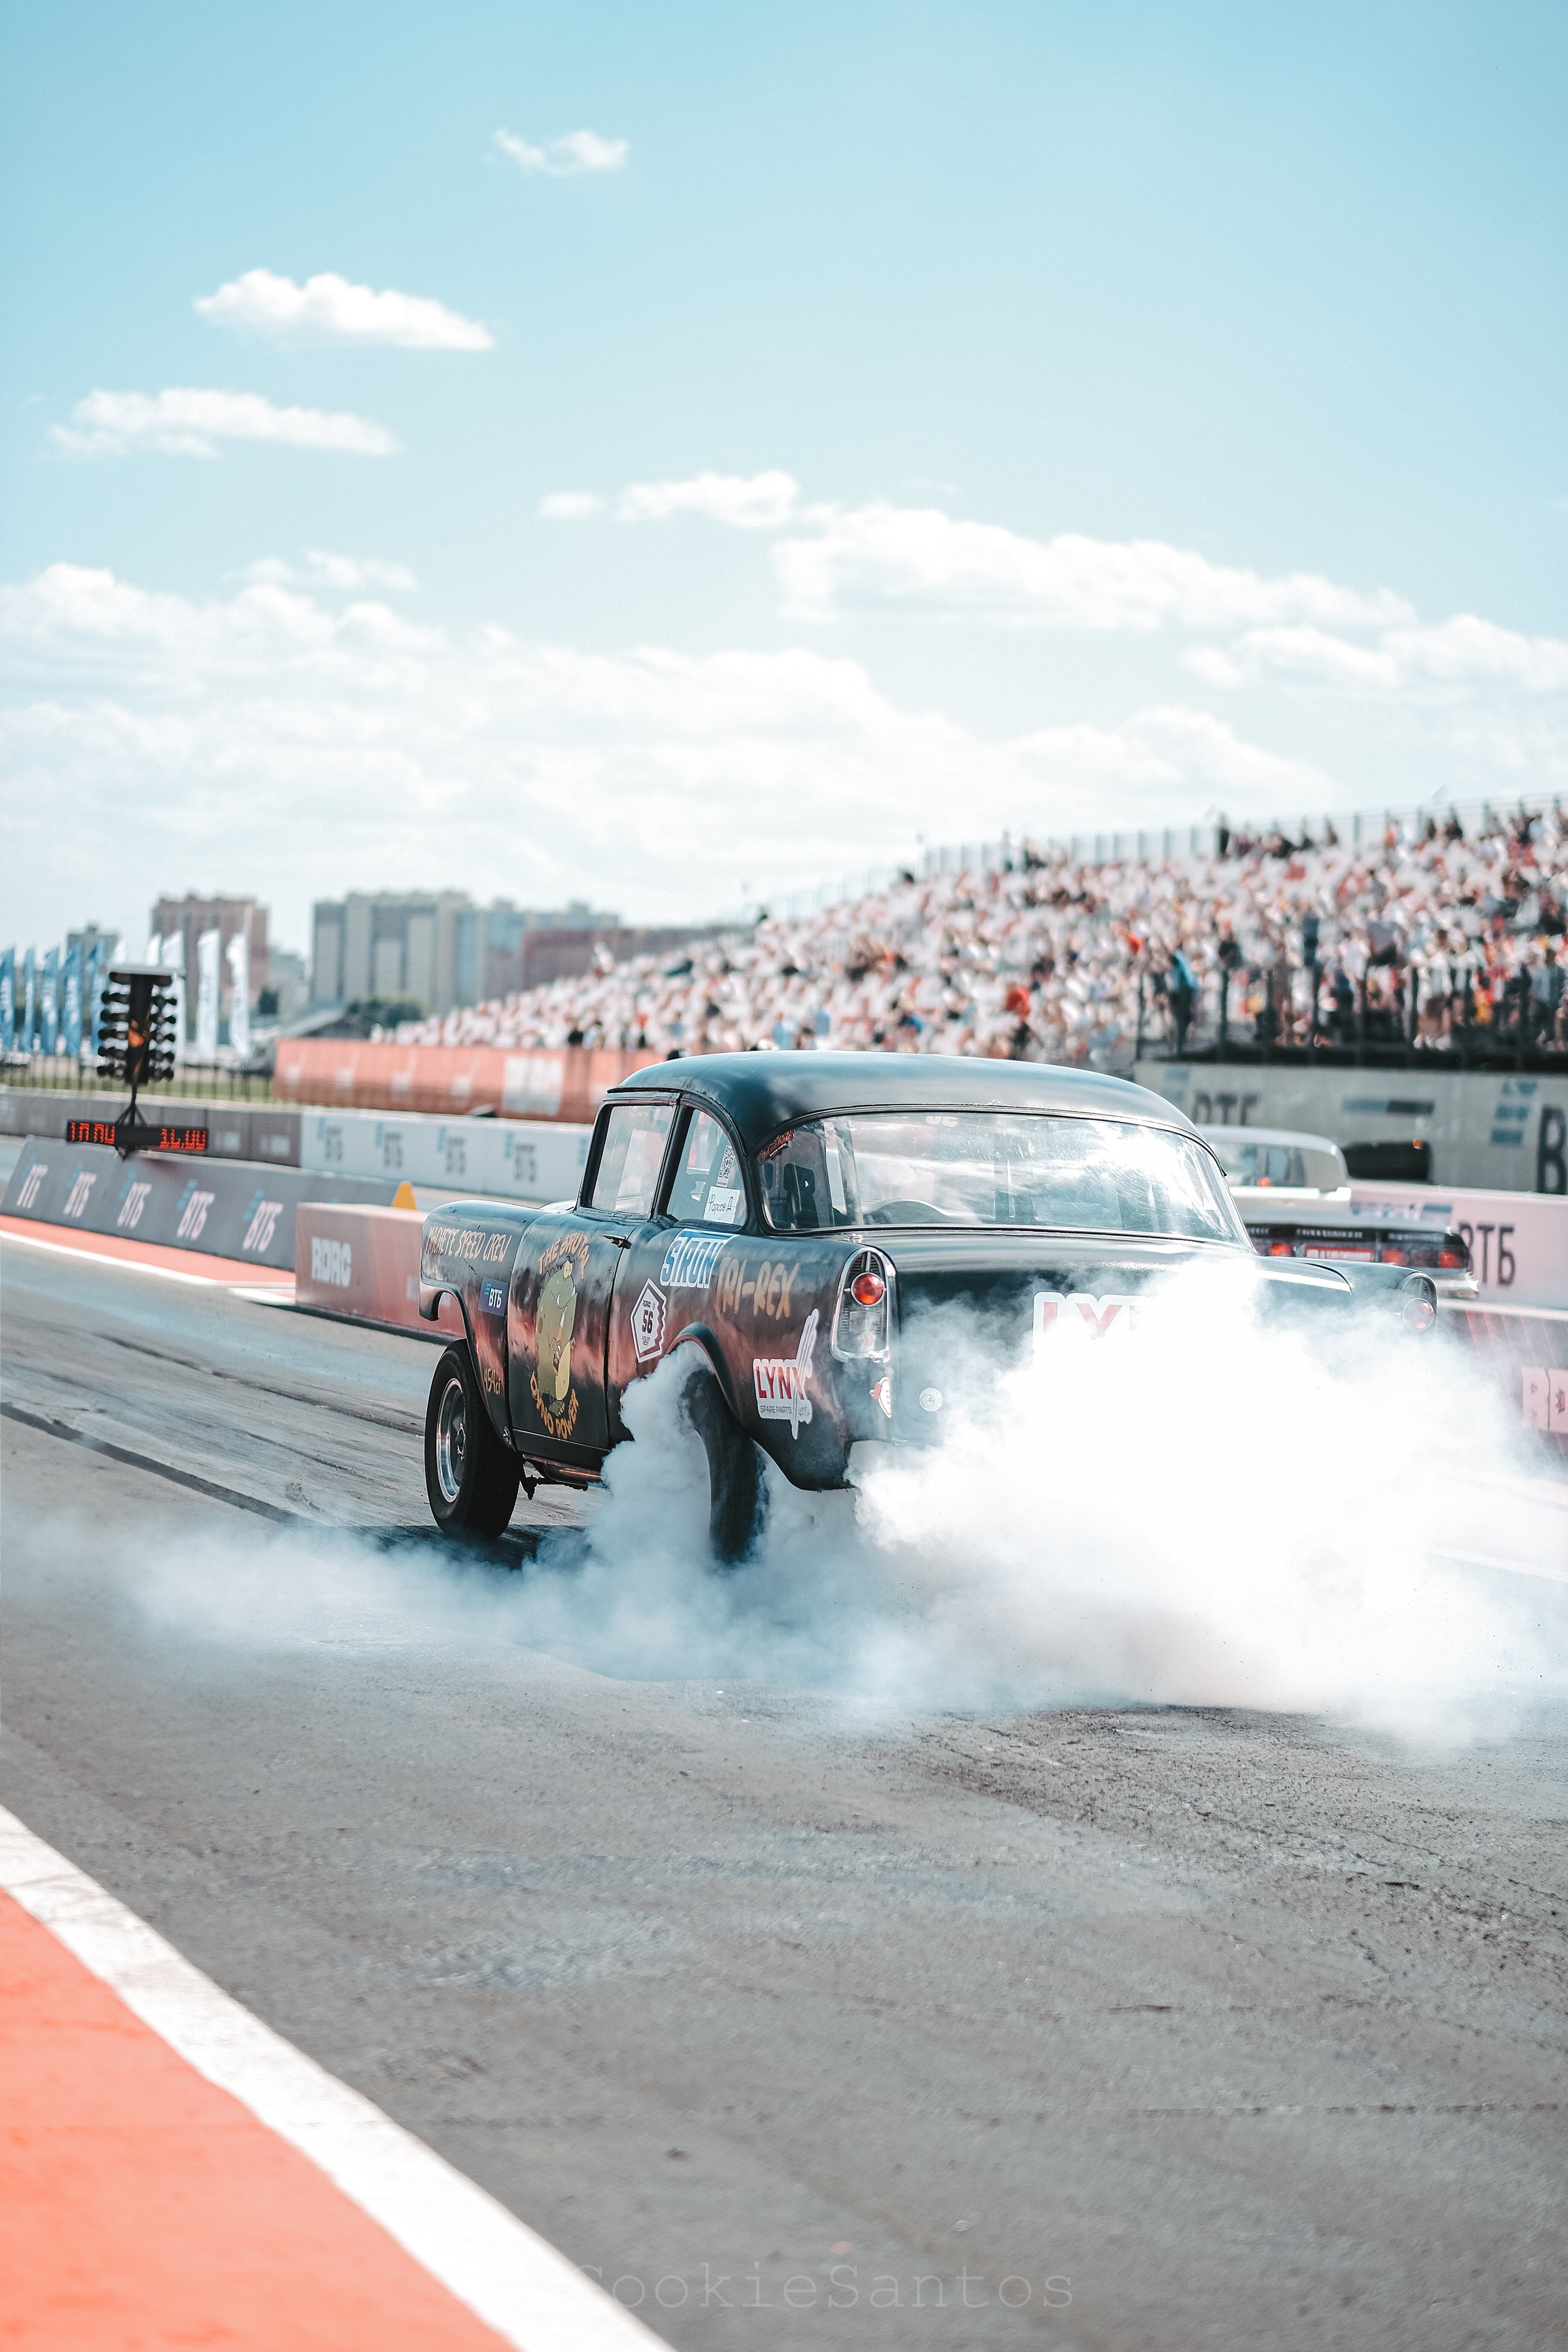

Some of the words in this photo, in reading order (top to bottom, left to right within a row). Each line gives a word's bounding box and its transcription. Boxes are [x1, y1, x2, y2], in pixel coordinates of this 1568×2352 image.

[117, 1182, 152, 1229] ВТБ
[177, 1191, 215, 1241] ВТБ
[242, 1200, 284, 1252] ВТБ
[426, 1226, 459, 1257] MACHETE
[454, 1230, 486, 1260] SPEED
[483, 1233, 512, 1262] CREW
[311, 1236, 352, 1289] RDRC
[538, 1237, 562, 1275] THE
[488, 1288, 503, 1308] ВТБ
[715, 1257, 801, 1321] TRI-REX
[641, 1309, 654, 1334] 56
[483, 1368, 501, 1395] 454ci
[755, 1365, 805, 1401] LYNX
[530, 1371, 554, 1434] DYNO
[555, 1388, 579, 1439] POWER
[760, 1404, 776, 1414] SPARE
[776, 1406, 792, 1414] PARTS
